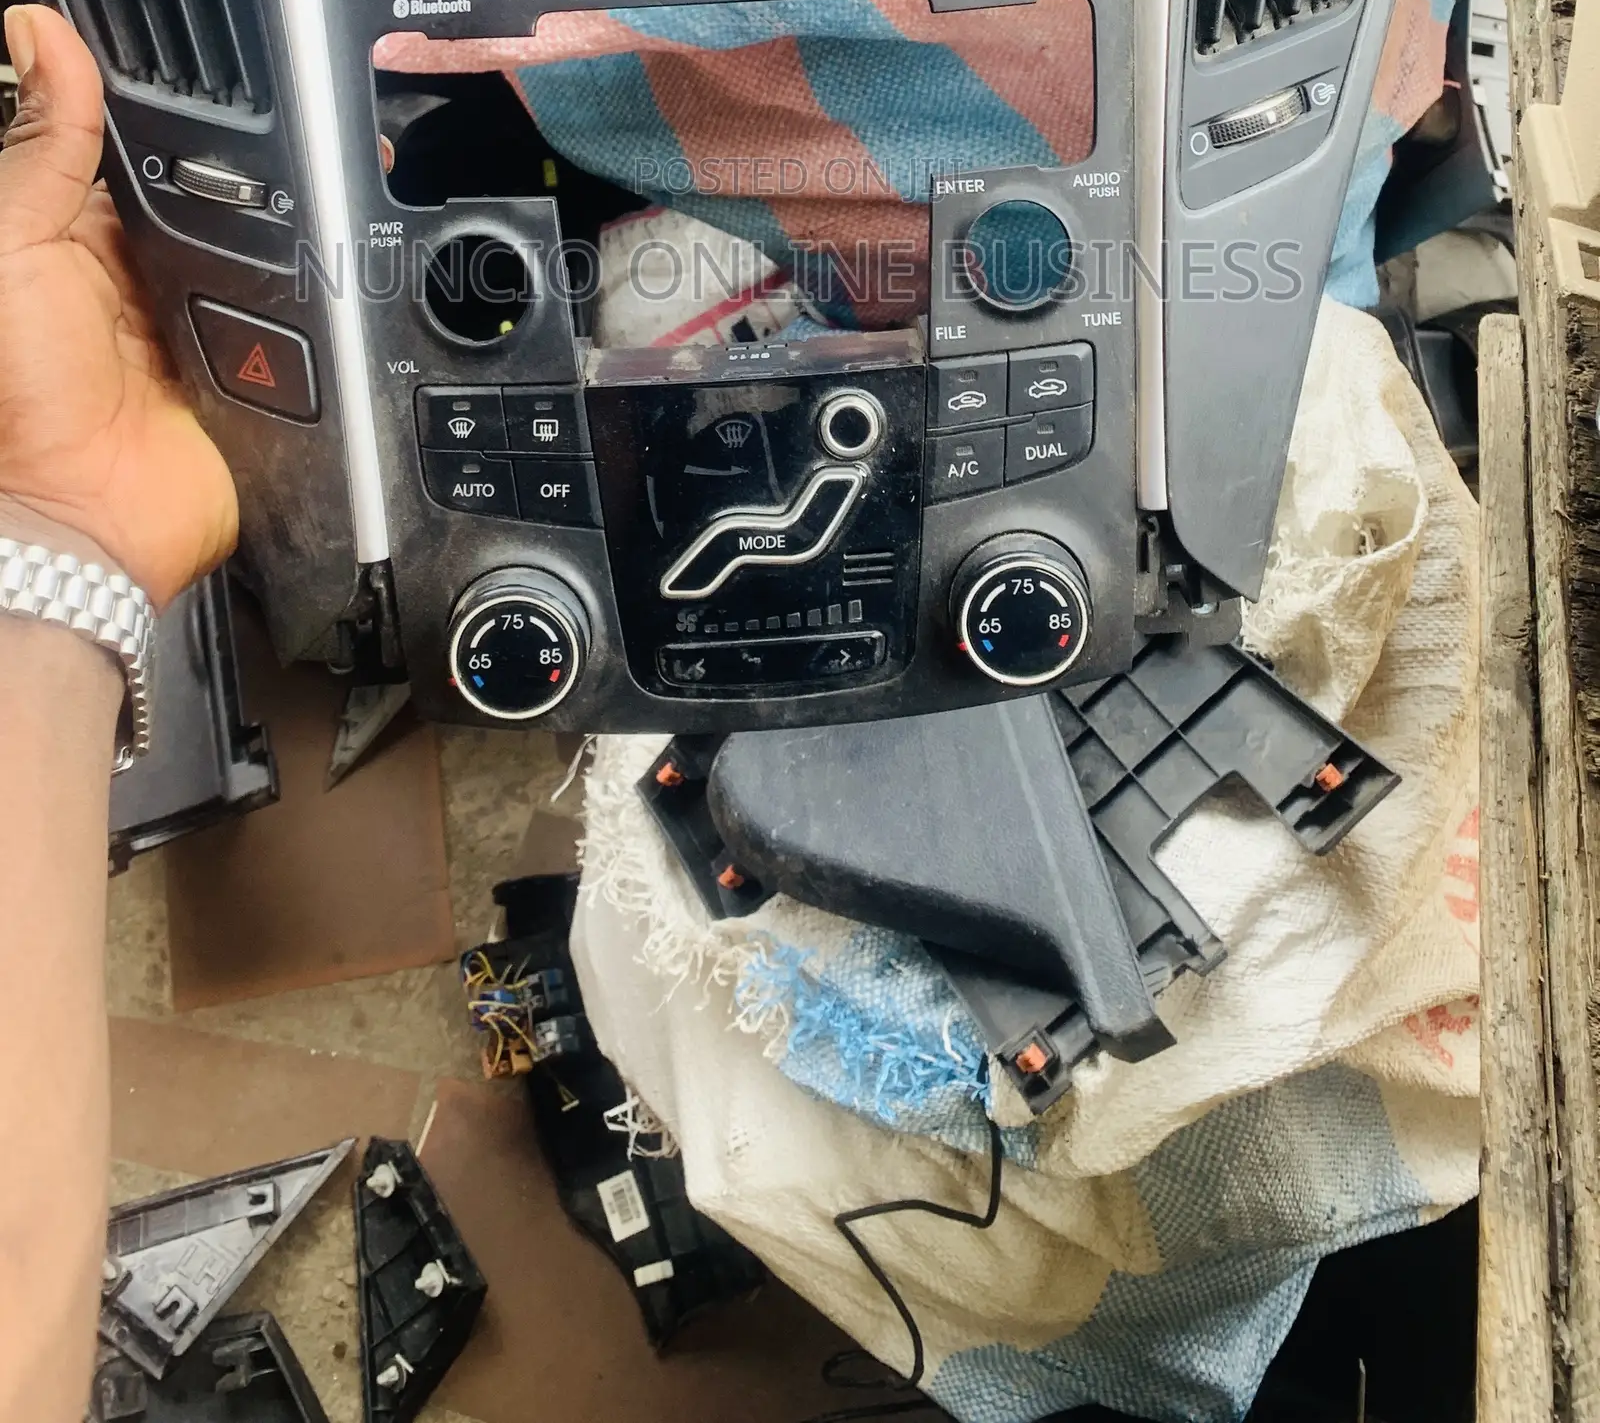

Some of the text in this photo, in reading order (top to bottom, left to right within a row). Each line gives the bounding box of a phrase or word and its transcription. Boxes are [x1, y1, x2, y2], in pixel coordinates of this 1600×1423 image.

[935, 178, 986, 195] ENTER
[1072, 171, 1122, 188] AUDIO
[1088, 186, 1121, 199] PUSH
[369, 221, 405, 237] PWR
[370, 236, 402, 249] PUSH
[1081, 312, 1122, 328] TUNE
[935, 325, 967, 341] FILE
[386, 360, 420, 375] VOL
[1024, 443, 1068, 461] DUAL
[947, 461, 980, 479] A/C
[452, 483, 496, 498] AUTO
[540, 483, 571, 498] OFF
[739, 534, 786, 551] MODE
[1011, 578, 1035, 596] 75
[500, 613, 525, 631] 75
[978, 617, 1002, 634] 65
[1048, 613, 1072, 630] 85
[468, 653, 492, 670] 65
[539, 647, 563, 665] 85
